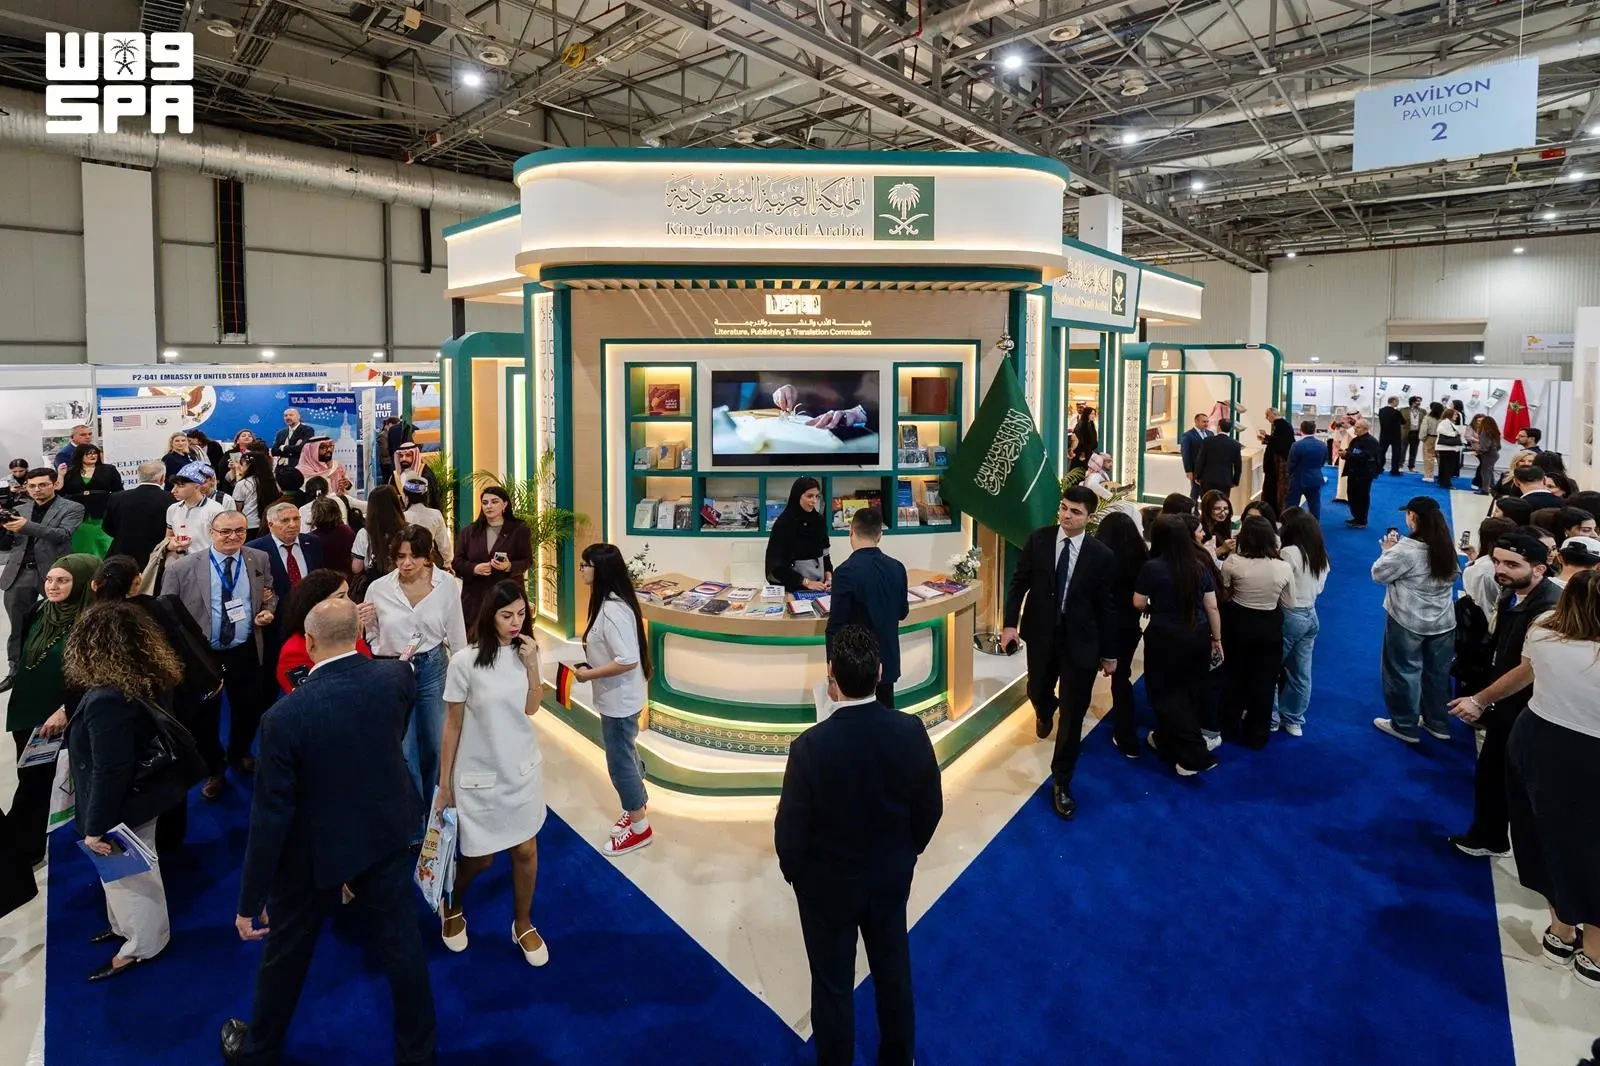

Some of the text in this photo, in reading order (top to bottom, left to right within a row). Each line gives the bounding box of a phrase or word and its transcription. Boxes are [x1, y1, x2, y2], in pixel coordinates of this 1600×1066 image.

[1402, 98, 1479, 120] PAVILION
[1431, 122, 1448, 142] 2
[664, 172, 866, 217] المملكة العربية السعودية
[665, 222, 864, 238] Kingdom of Saudi Arabia
[714, 328, 750, 336] Literature,
[751, 328, 785, 337] Publishing
[358, 403, 392, 411] GTHE
